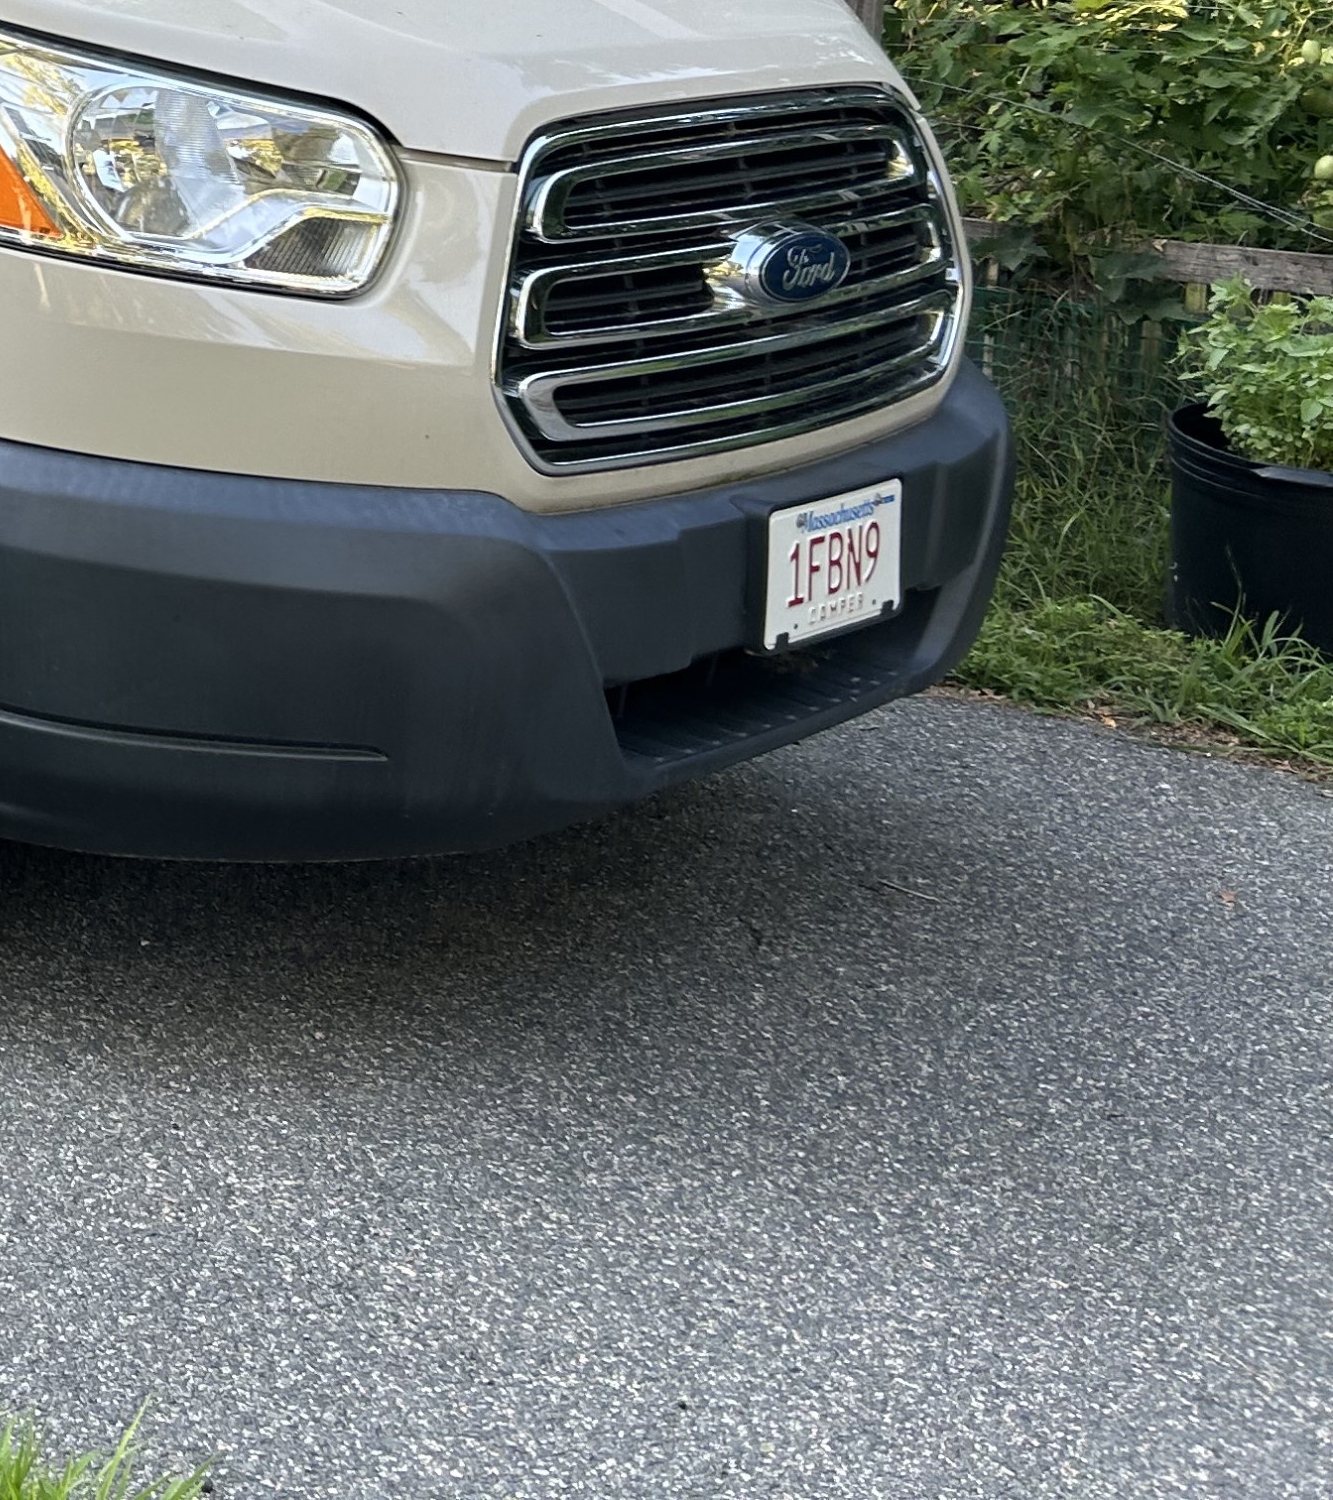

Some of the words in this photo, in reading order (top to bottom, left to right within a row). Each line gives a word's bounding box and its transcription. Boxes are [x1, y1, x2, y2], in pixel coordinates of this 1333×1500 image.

[783, 244, 835, 291] Ford
[804, 502, 875, 533] Massachusetts
[786, 520, 880, 609] 1FBN9
[808, 592, 863, 625] CAMPER
